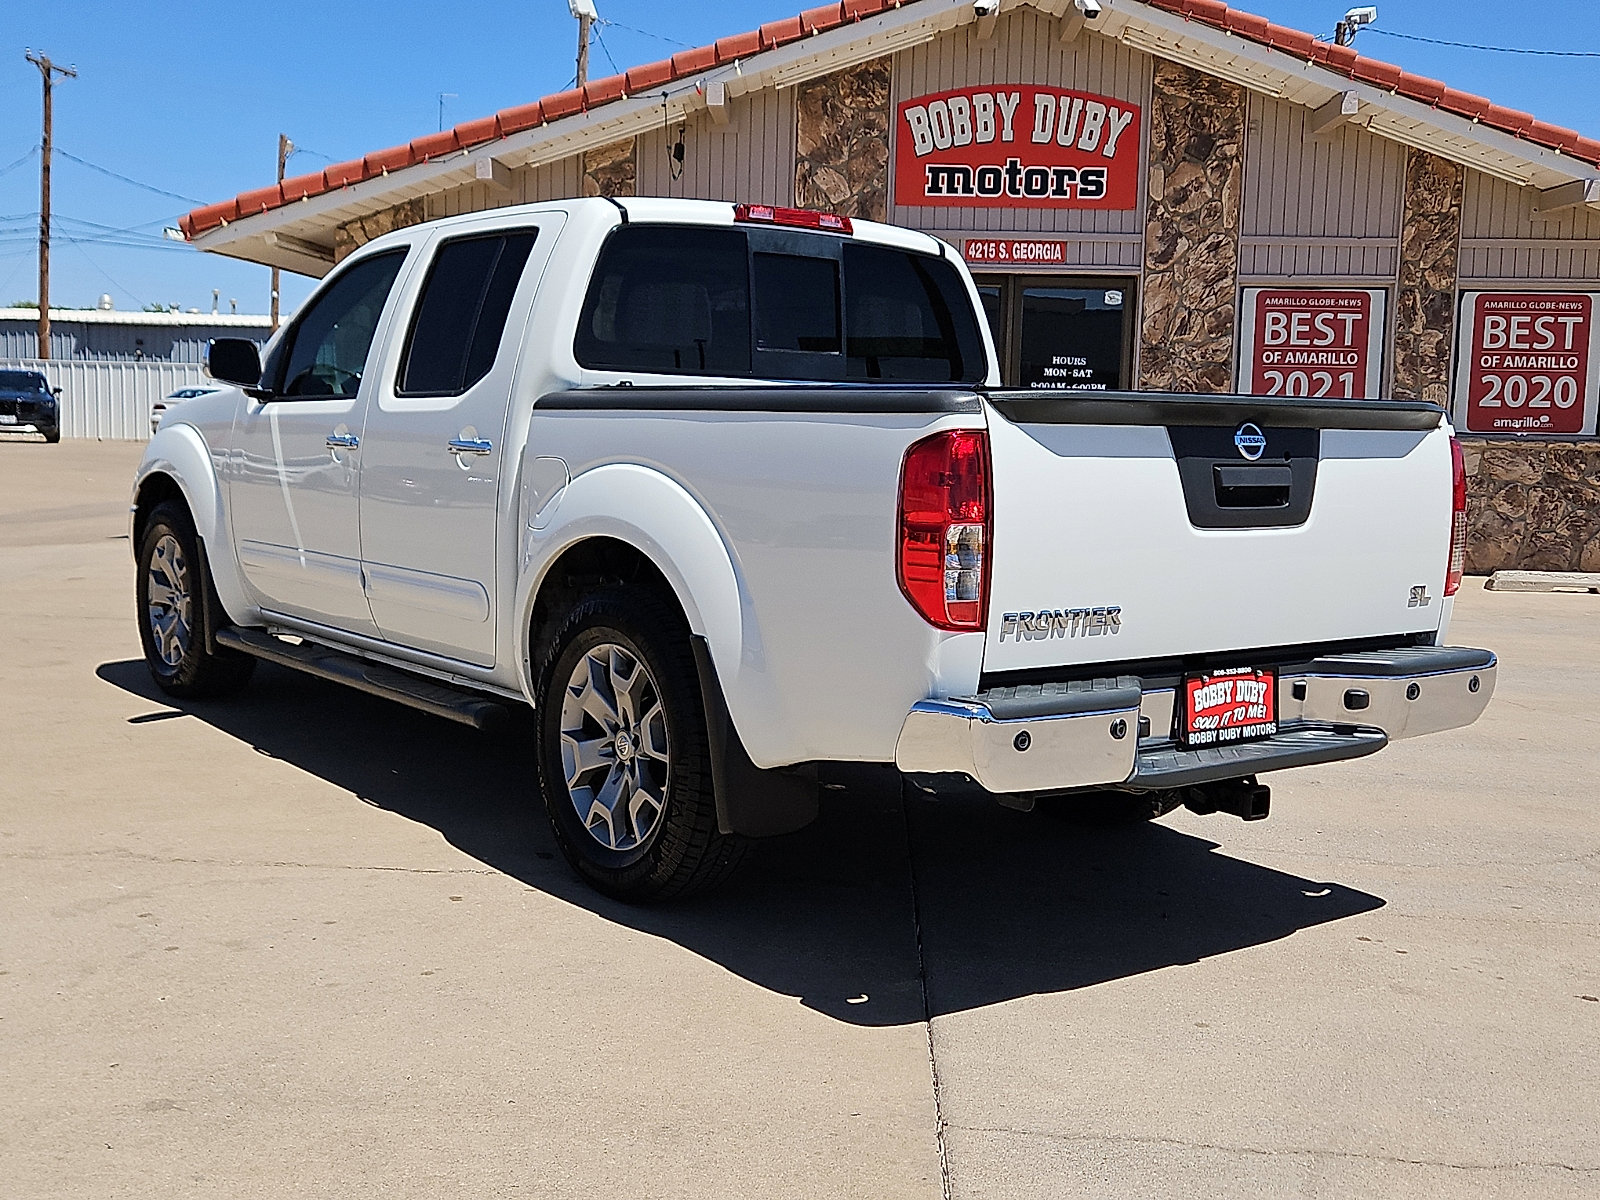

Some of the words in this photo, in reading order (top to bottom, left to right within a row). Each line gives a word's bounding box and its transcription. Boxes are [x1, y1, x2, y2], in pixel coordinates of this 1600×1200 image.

[904, 92, 1020, 157] BOBBY
[1031, 93, 1134, 158] DUBY
[924, 157, 1108, 200] motors
[968, 242, 996, 259] 4215
[998, 243, 1009, 259] S.
[1012, 243, 1062, 260] GEORGIA
[1264, 297, 1308, 306] AMARILLO
[1308, 298, 1362, 307] GLOBE-NEWS
[1484, 301, 1527, 309] AMARILLO
[1528, 302, 1583, 310] GLOBE-NEWS
[1263, 312, 1363, 347] BEST
[1482, 315, 1584, 350] BEST
[1052, 356, 1087, 366] HOURS
[1262, 351, 1282, 364] OF
[1284, 351, 1359, 365] AMARILLO
[1480, 355, 1500, 367] OF
[1503, 356, 1579, 369] AMARILLO
[1262, 370, 1354, 398] 2021
[1478, 374, 1578, 409] 2020
[1238, 436, 1265, 445] NISSAN
[1408, 585, 1431, 607] SL
[1000, 605, 1121, 641] FRONTIER
[1193, 680, 1234, 713] BOBBY
[1235, 680, 1267, 704] DUBY
[1192, 715, 1219, 729] SOLD
[1220, 711, 1232, 727] IT
[1233, 706, 1246, 723] TO
[1188, 730, 1217, 745] BOBBY
[1219, 727, 1241, 741] DUBY
[1242, 722, 1277, 738] MOTORS
